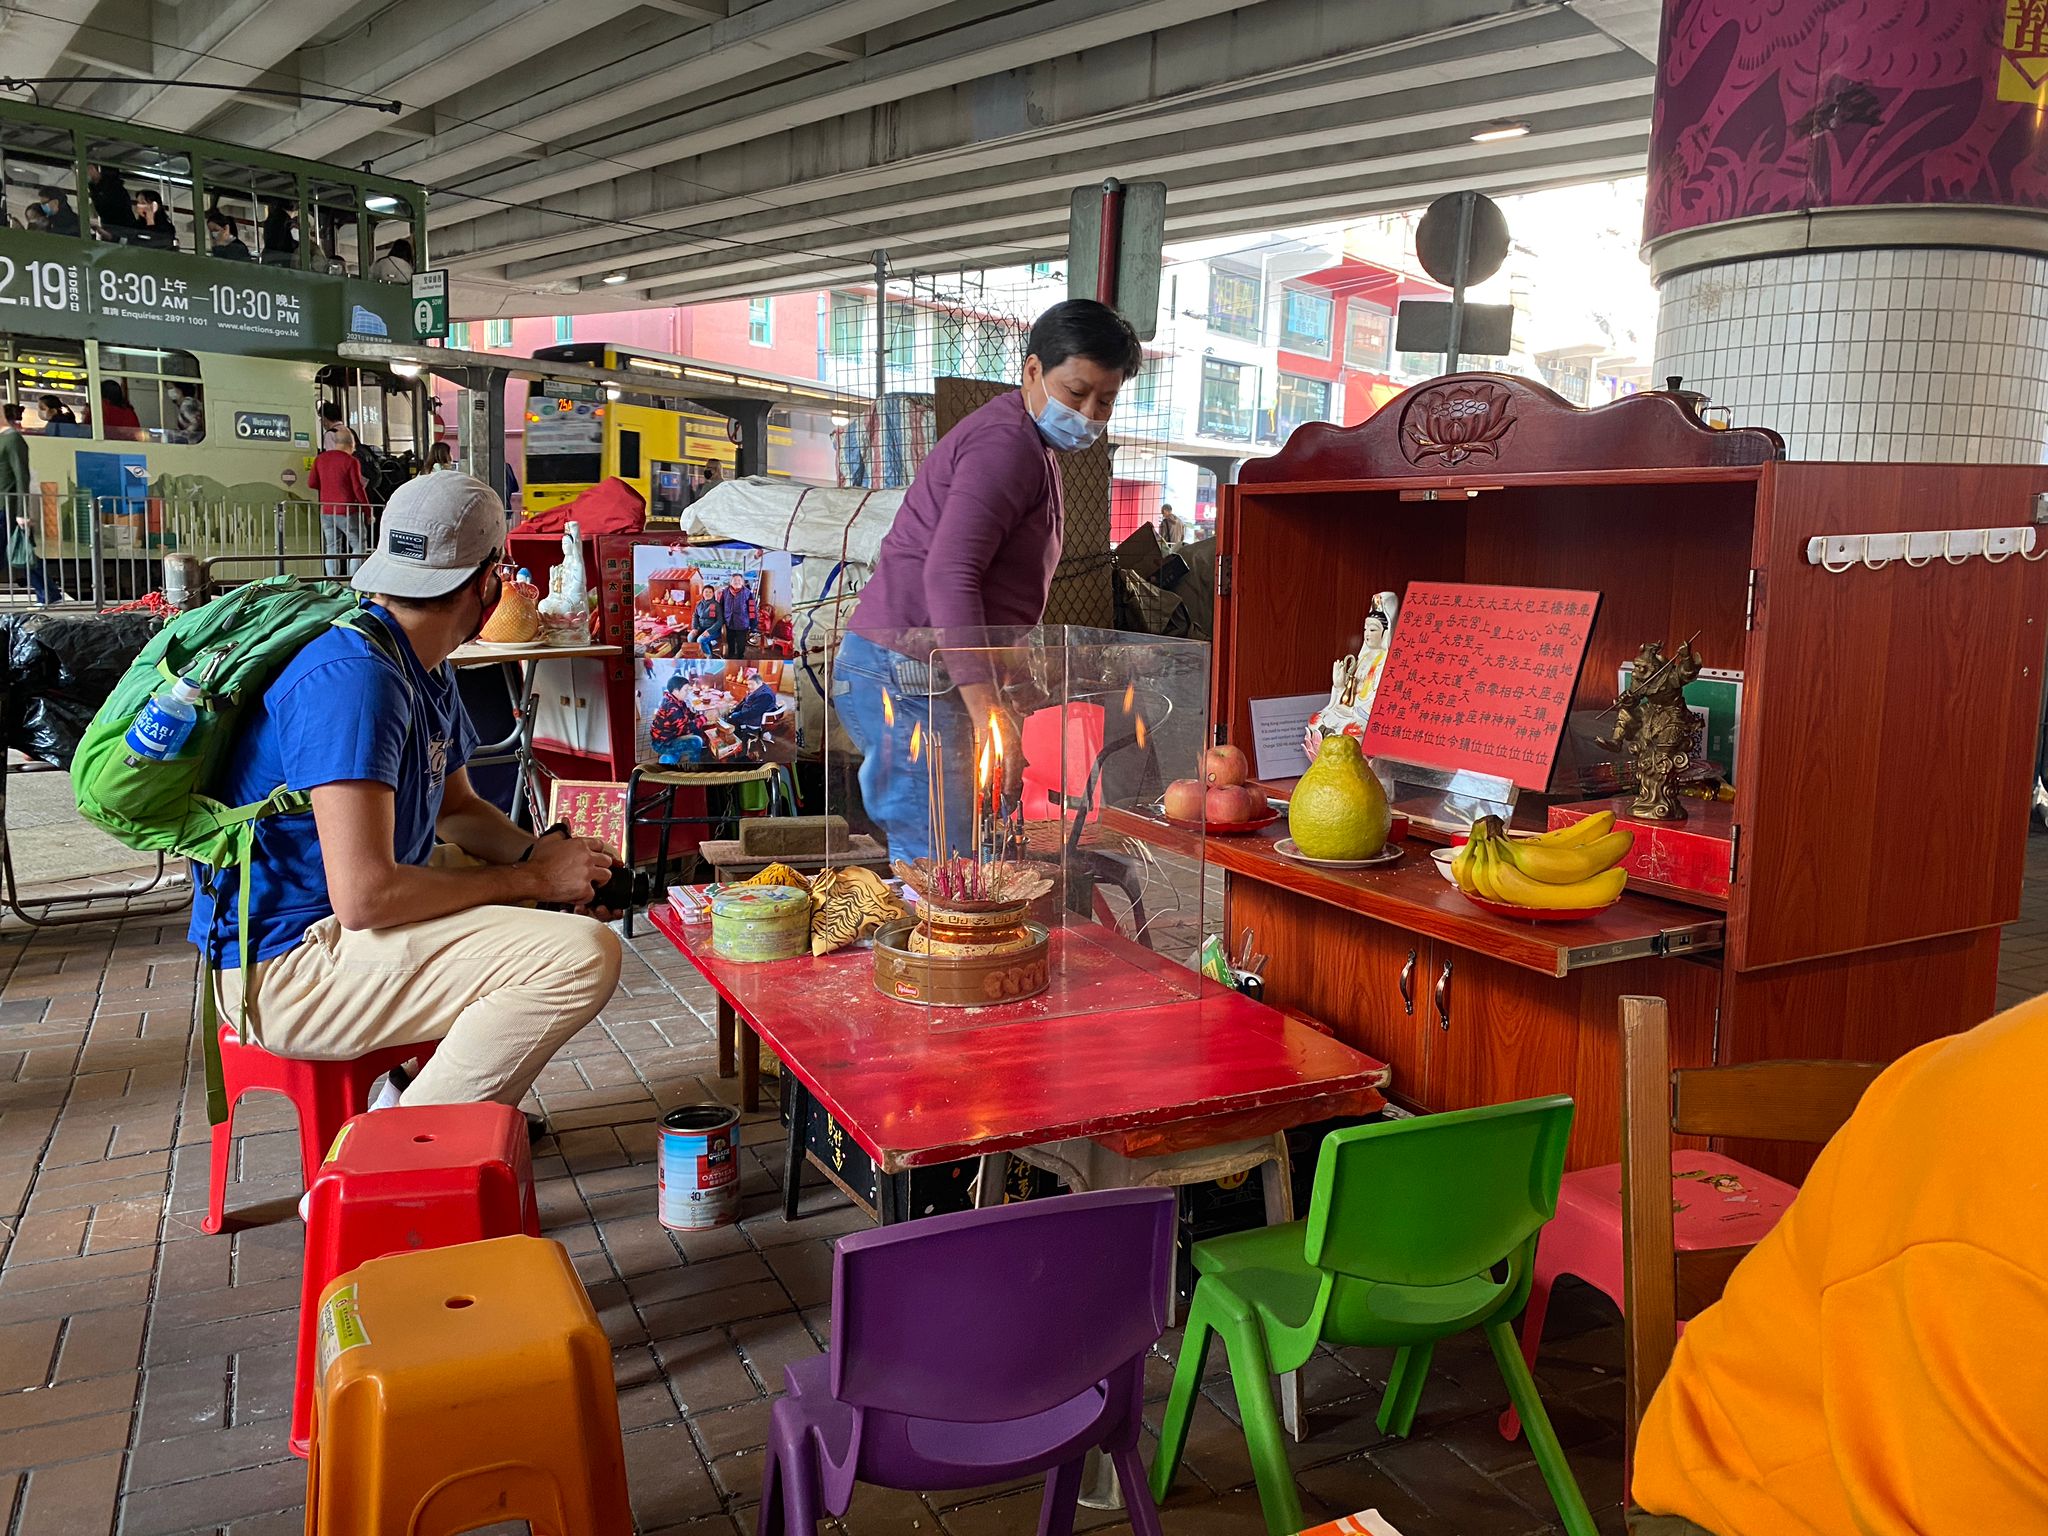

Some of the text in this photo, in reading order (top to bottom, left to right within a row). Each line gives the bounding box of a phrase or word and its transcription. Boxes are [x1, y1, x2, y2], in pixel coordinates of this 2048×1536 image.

[100, 270, 156, 306] 8:30
[160, 278, 187, 293] 上午
[161, 295, 188, 310] AM
[209, 284, 271, 320] 10:30
[275, 294, 300, 309] 晚上
[121, 307, 163, 321] Enquiries:
[165, 314, 185, 323] 2891
[188, 317, 208, 326] 1001
[277, 310, 299, 324] PM
[218, 322, 299, 337] www.elections.gov.hk
[237, 415, 251, 437] 6
[142, 711, 174, 737] OCARI
